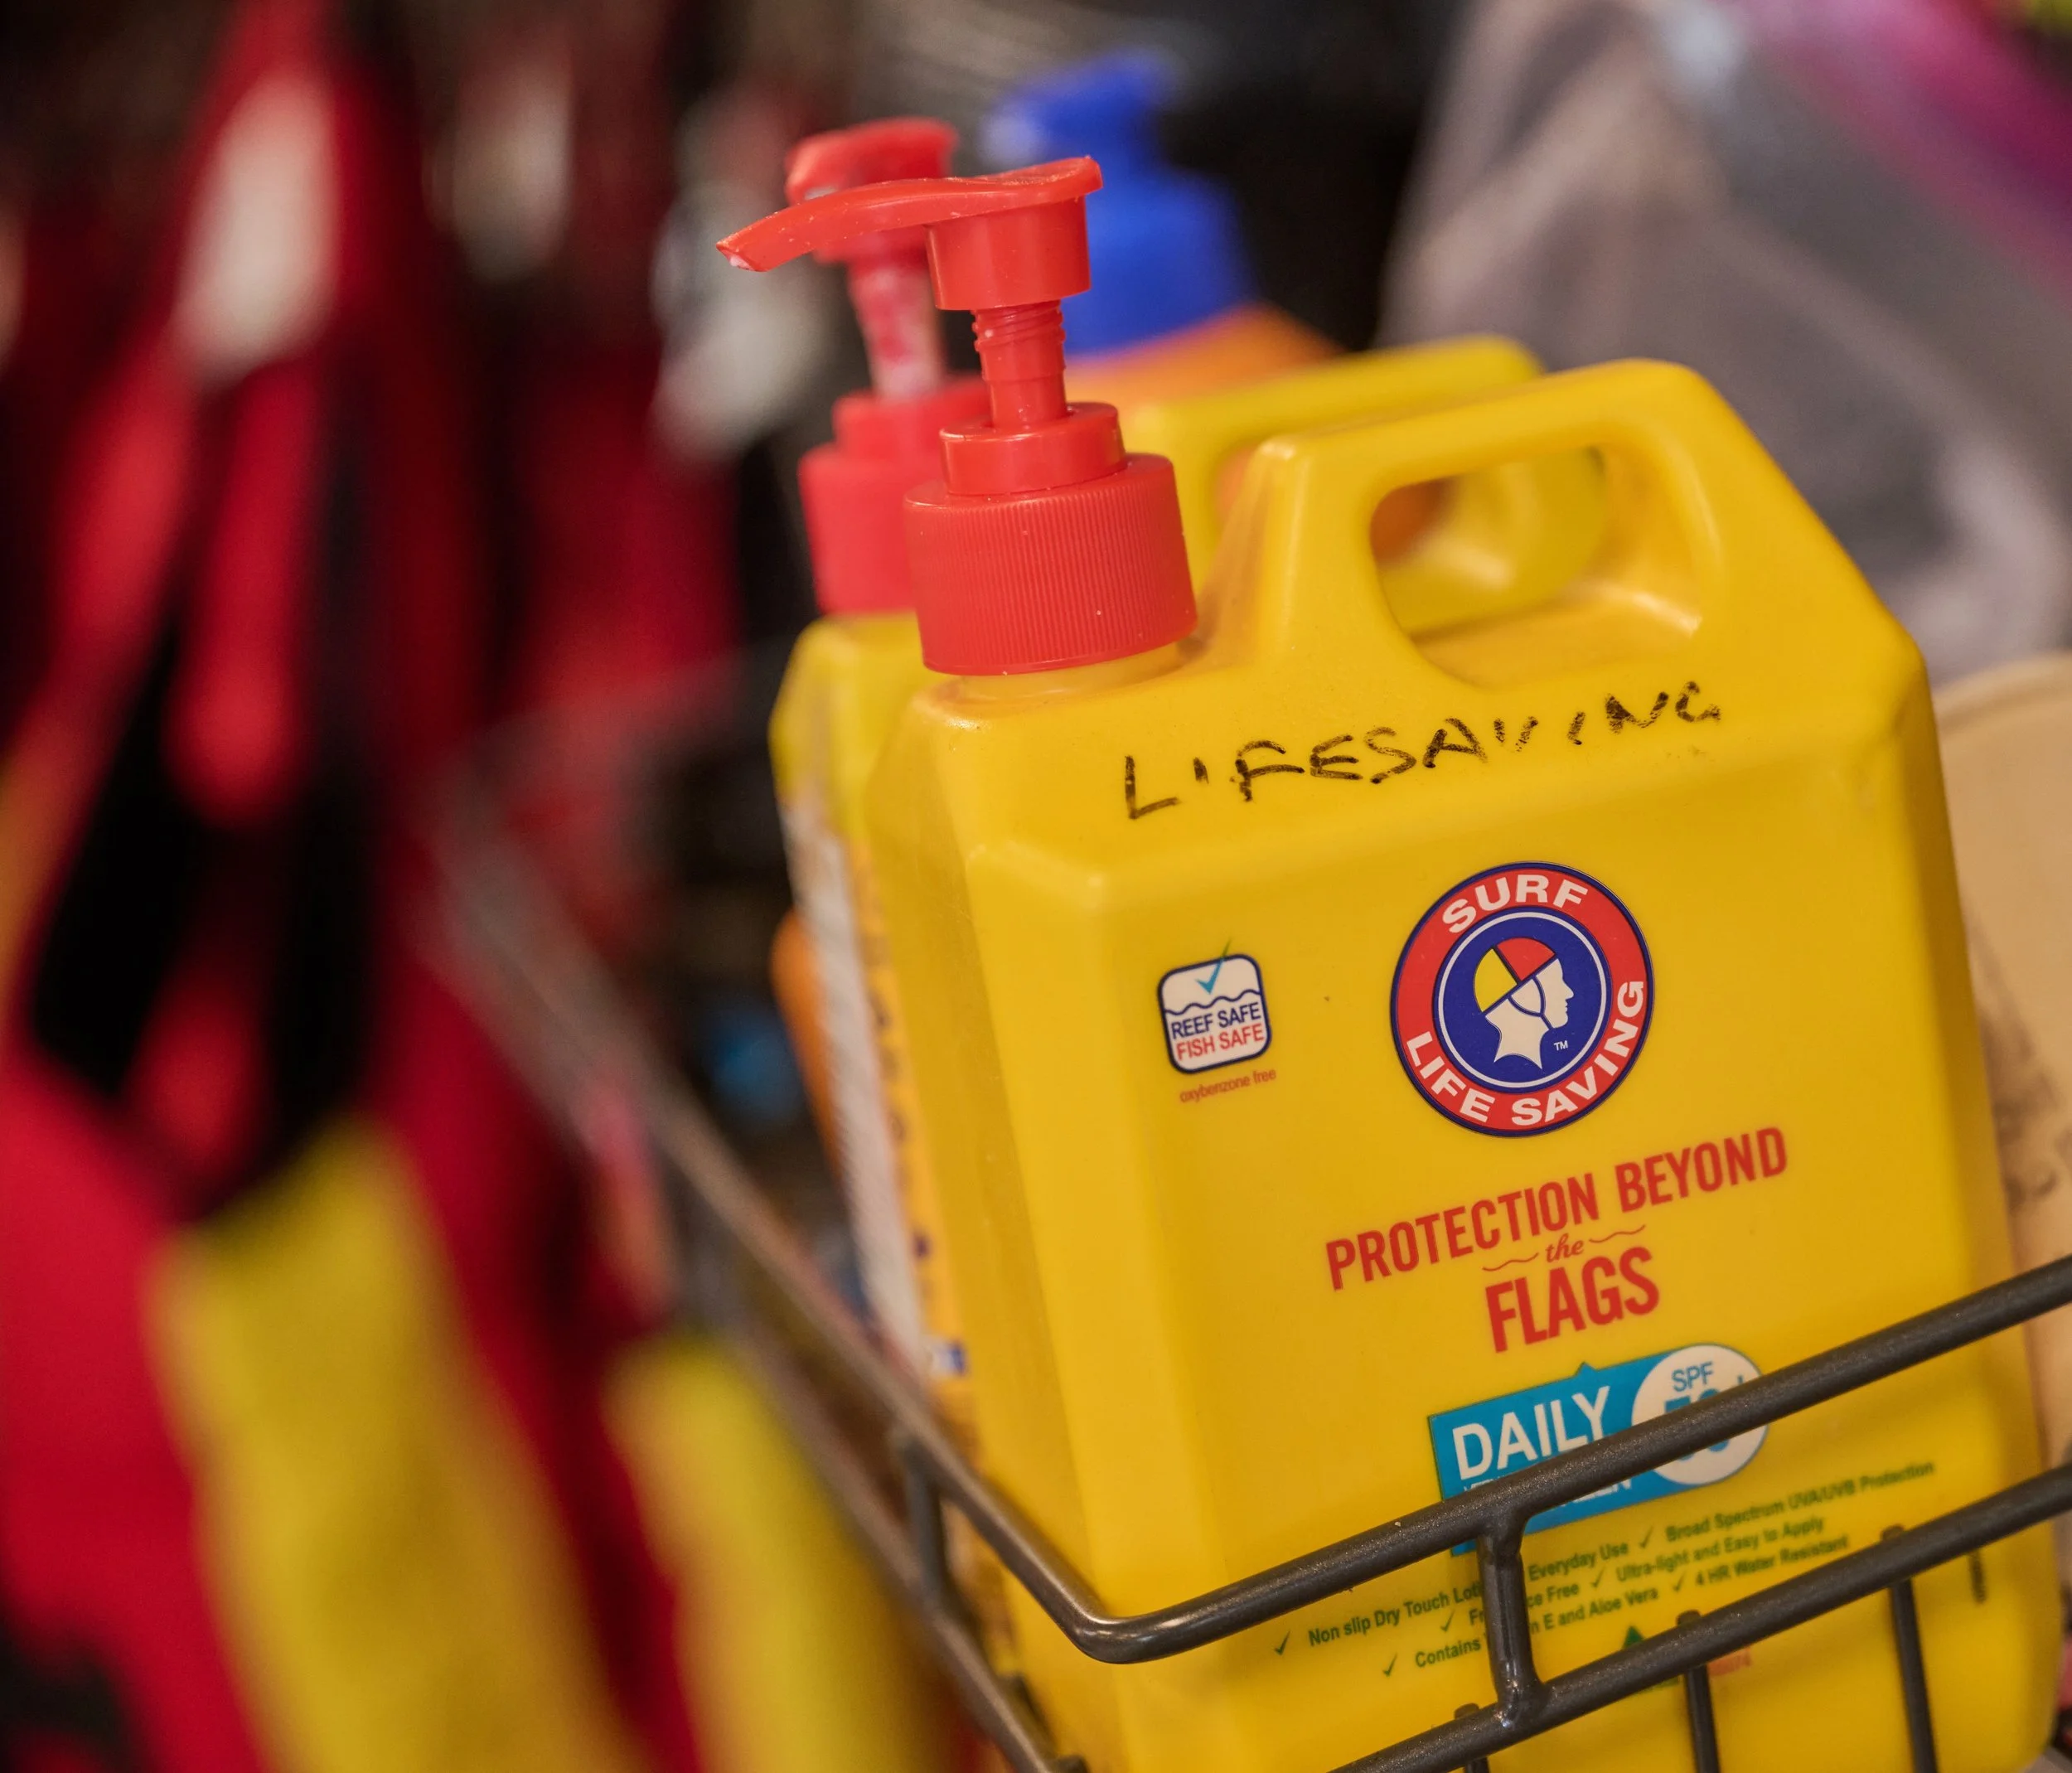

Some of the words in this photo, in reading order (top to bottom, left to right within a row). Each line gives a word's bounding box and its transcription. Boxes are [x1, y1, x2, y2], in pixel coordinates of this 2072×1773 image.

[1124, 681, 1721, 820] LIFESAVING
[1442, 873, 1588, 934] SURF
[1171, 1013, 1213, 1039] REEF
[1218, 1001, 1261, 1028] SAFE
[1176, 1036, 1215, 1061] FISH
[1218, 1023, 1264, 1050] SAFE
[1407, 1031, 1495, 1122] LIFE
[1511, 981, 1644, 1126] SAVING
[1553, 1039, 1568, 1051] TM
[1179, 1075, 1251, 1102] oxybenzone
[1253, 1068, 1276, 1085] free
[1326, 1173, 1600, 1291] PROTECTION
[1615, 1127, 1788, 1213] BEYOND
[1546, 1233, 1584, 1262] the
[1485, 1247, 1660, 1354] FLAGS
[1672, 1360, 1713, 1392] SPF
[1452, 1385, 1610, 1480] DAILY
[1308, 1627, 1340, 1646] Non
[1343, 1616, 1371, 1635] slip
[1374, 1608, 1401, 1627] Dry
[1403, 1591, 1450, 1618] Touch
[1527, 1552, 1596, 1582] Everyday
[1599, 1542, 1629, 1561] Use
[1665, 1518, 1711, 1543] Broad
[1713, 1500, 1784, 1529] Spectrum
[1788, 1480, 1856, 1510] UVA/UVB
[1859, 1461, 1934, 1489] Protection
[1546, 1583, 1580, 1603] Free
[1616, 1549, 1691, 1582] Ultra-light
[1693, 1543, 1720, 1562] and
[1724, 1534, 1759, 1554] Easy
[1763, 1528, 1778, 1542] to
[1783, 1516, 1823, 1538] Apply
[1416, 1638, 1481, 1668] Contains
[1543, 1613, 1554, 1630] E
[1558, 1604, 1585, 1625] and
[1590, 1597, 1621, 1616] Aloe
[1624, 1588, 1658, 1606] Vera
[1695, 1572, 1705, 1586] 4
[1707, 1564, 1730, 1581] HR
[1734, 1556, 1774, 1576] Water
[1779, 1535, 1849, 1562] Resistant
